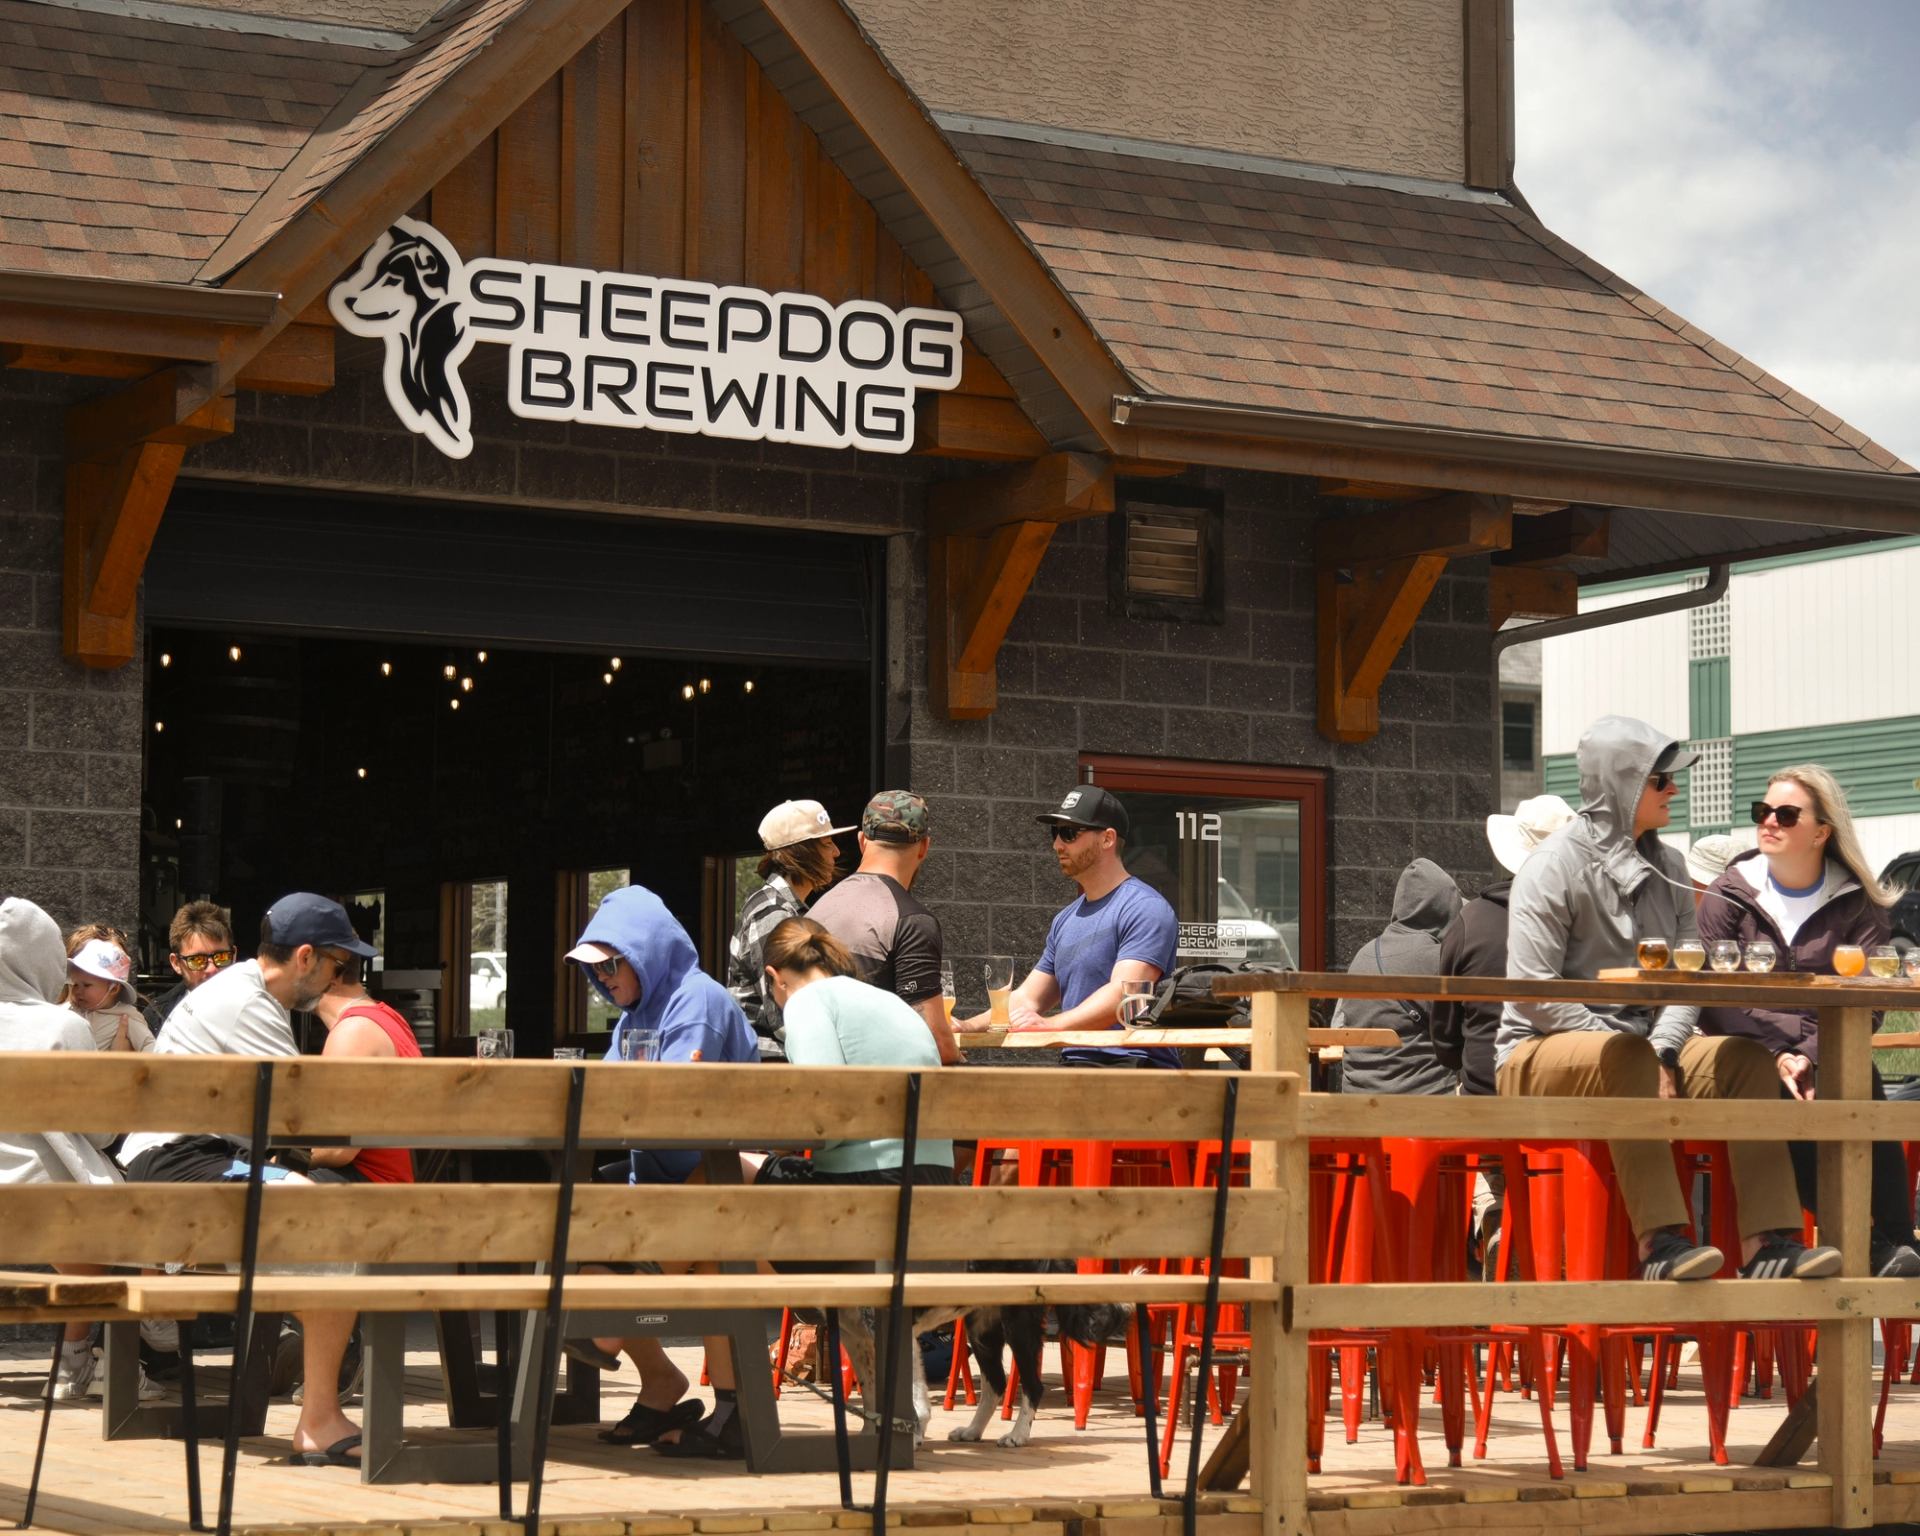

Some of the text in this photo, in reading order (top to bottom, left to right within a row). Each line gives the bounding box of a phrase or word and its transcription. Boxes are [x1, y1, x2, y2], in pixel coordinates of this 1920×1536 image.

[469, 269, 955, 378] SHEEPDOG
[520, 348, 906, 442] BREWING
[1175, 811, 1222, 841] 112
[1179, 936, 1238, 949] BREWING
